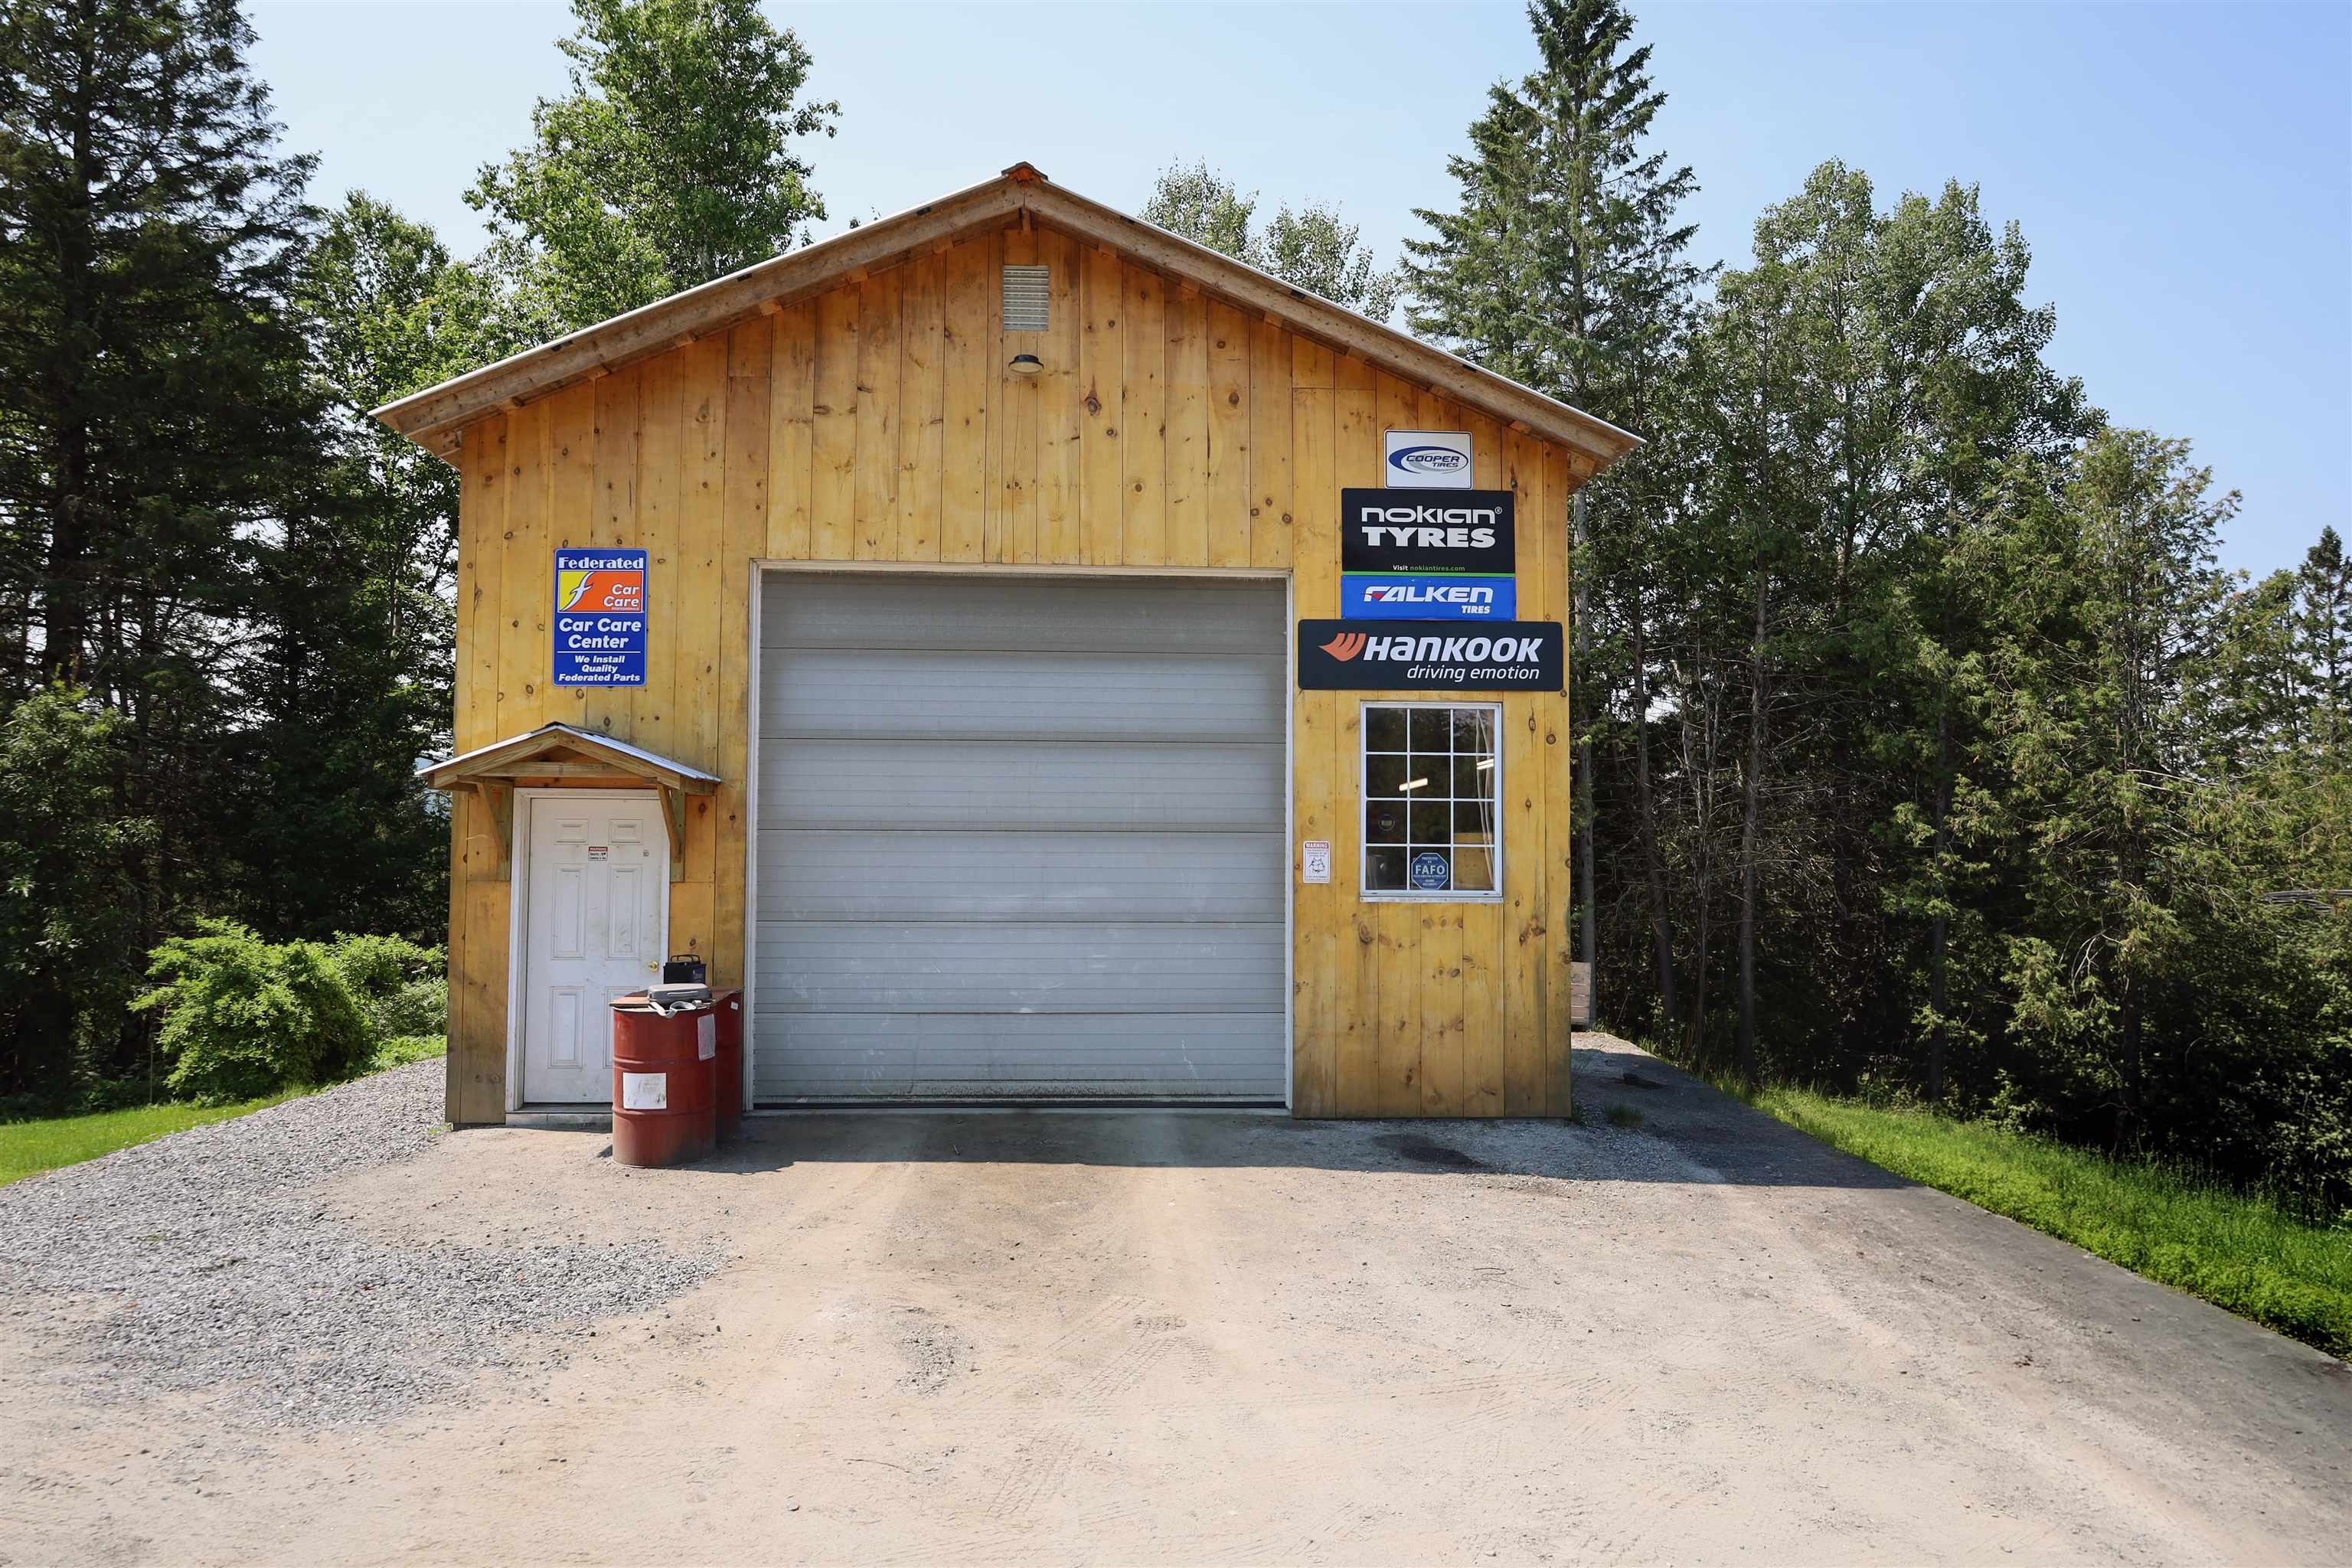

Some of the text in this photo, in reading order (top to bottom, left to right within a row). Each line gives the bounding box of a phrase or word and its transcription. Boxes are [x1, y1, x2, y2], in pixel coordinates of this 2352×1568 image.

[1361, 526, 1496, 548] TYRES
[558, 557, 644, 569] Federated
[612, 583, 639, 595] Car
[1364, 586, 1494, 603] FALKEN
[603, 596, 639, 606] Care
[1461, 605, 1491, 614] TIRES
[559, 618, 642, 632] Car Care
[568, 634, 629, 648] Center
[581, 665, 618, 674] Quality
[1406, 665, 1540, 683] driving emotion
[1415, 865, 1446, 875] FAFO
